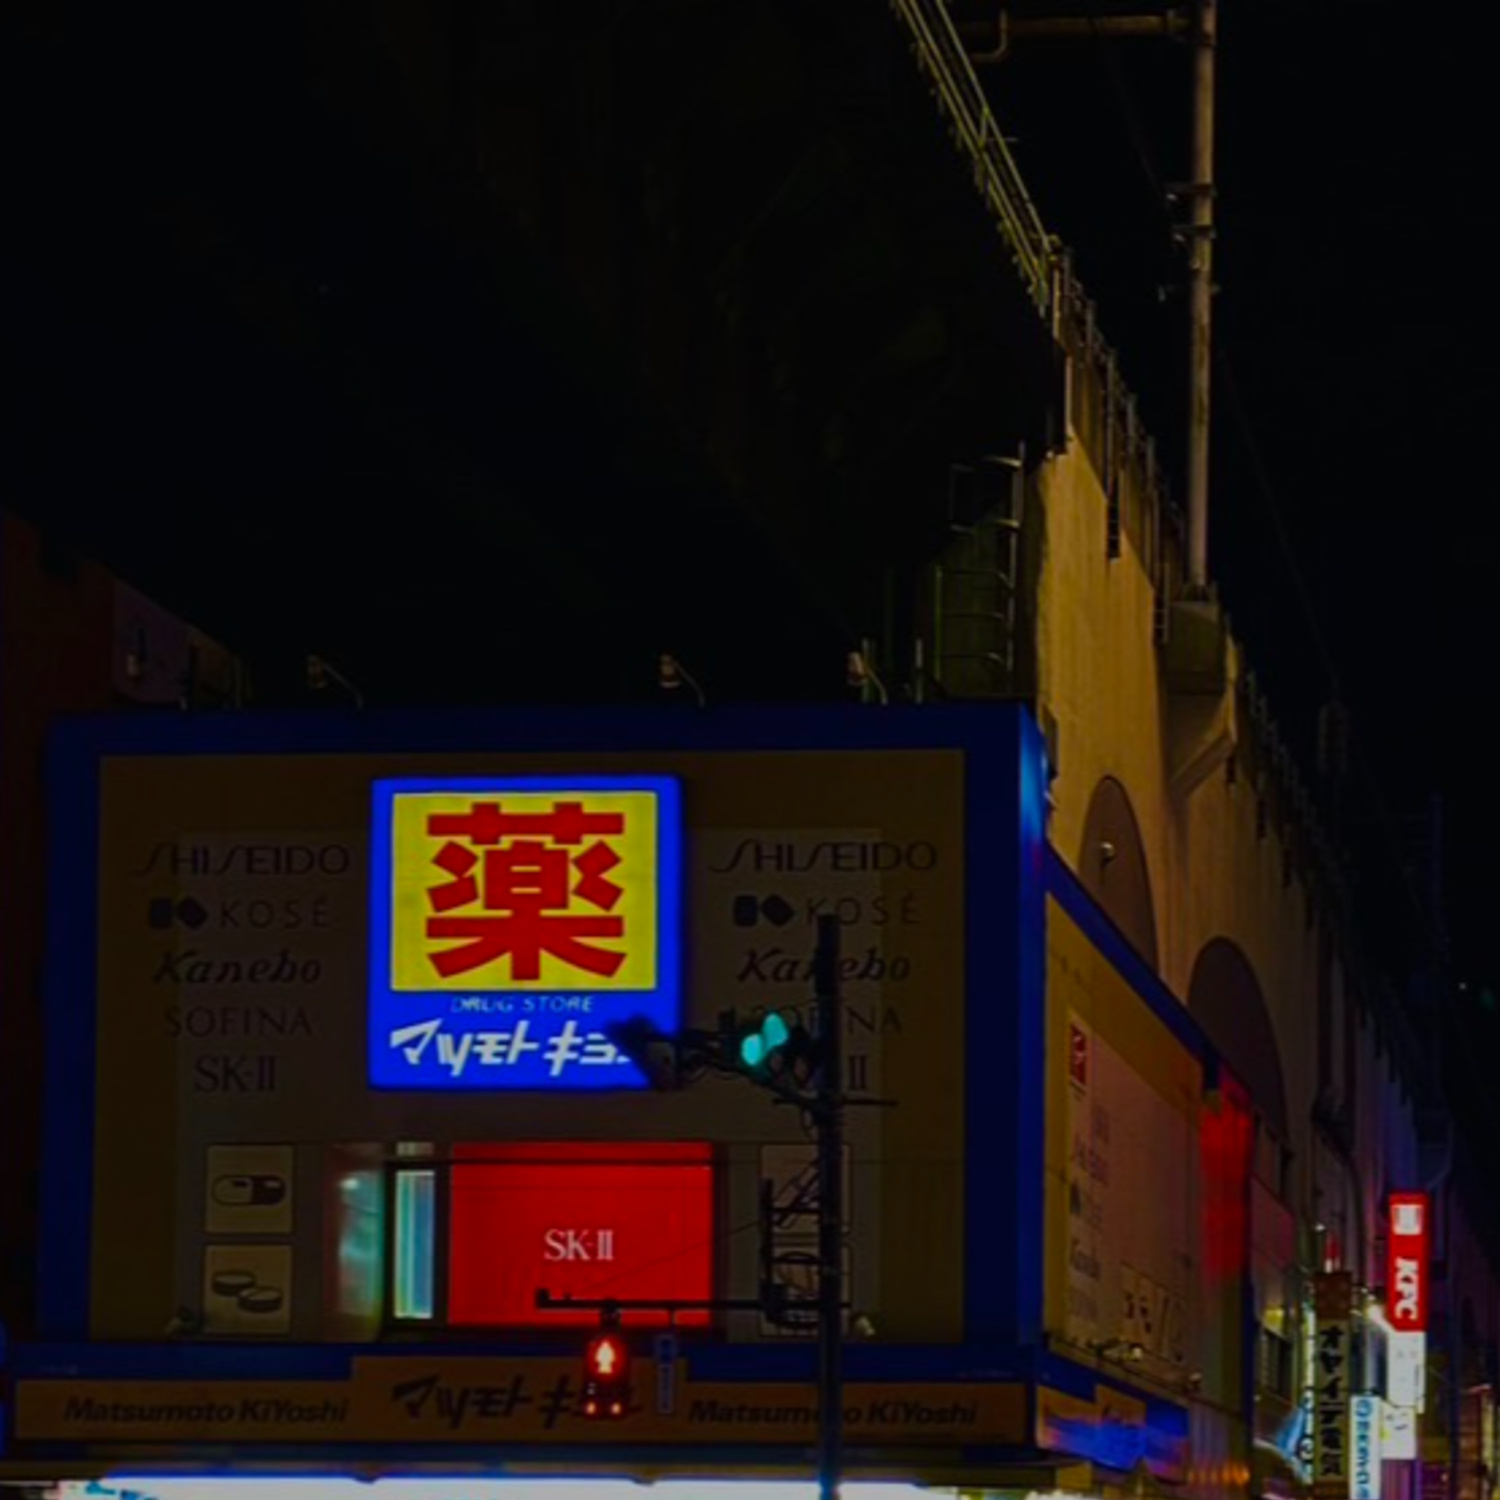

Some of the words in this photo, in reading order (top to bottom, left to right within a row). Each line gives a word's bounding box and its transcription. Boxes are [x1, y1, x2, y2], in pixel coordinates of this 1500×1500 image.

[131, 842, 350, 877] SHISEIDO
[710, 839, 937, 873] SHISEIDO
[427, 802, 627, 981] 薬
[152, 949, 322, 985] Kanebo
[163, 1005, 314, 1038] SOFINA
[450, 995, 514, 1013] DRUG
[522, 995, 594, 1013] STORE
[388, 1017, 633, 1078] マツモトキヨ
[1394, 1255, 1419, 1322] KFC
[63, 1395, 234, 1423] Matsumoto
[240, 1397, 348, 1424] KiYoshi
[392, 1373, 642, 1430] マツモトキ
[688, 1399, 862, 1425] Matsumo
[868, 1401, 977, 1425] KiYoshi
